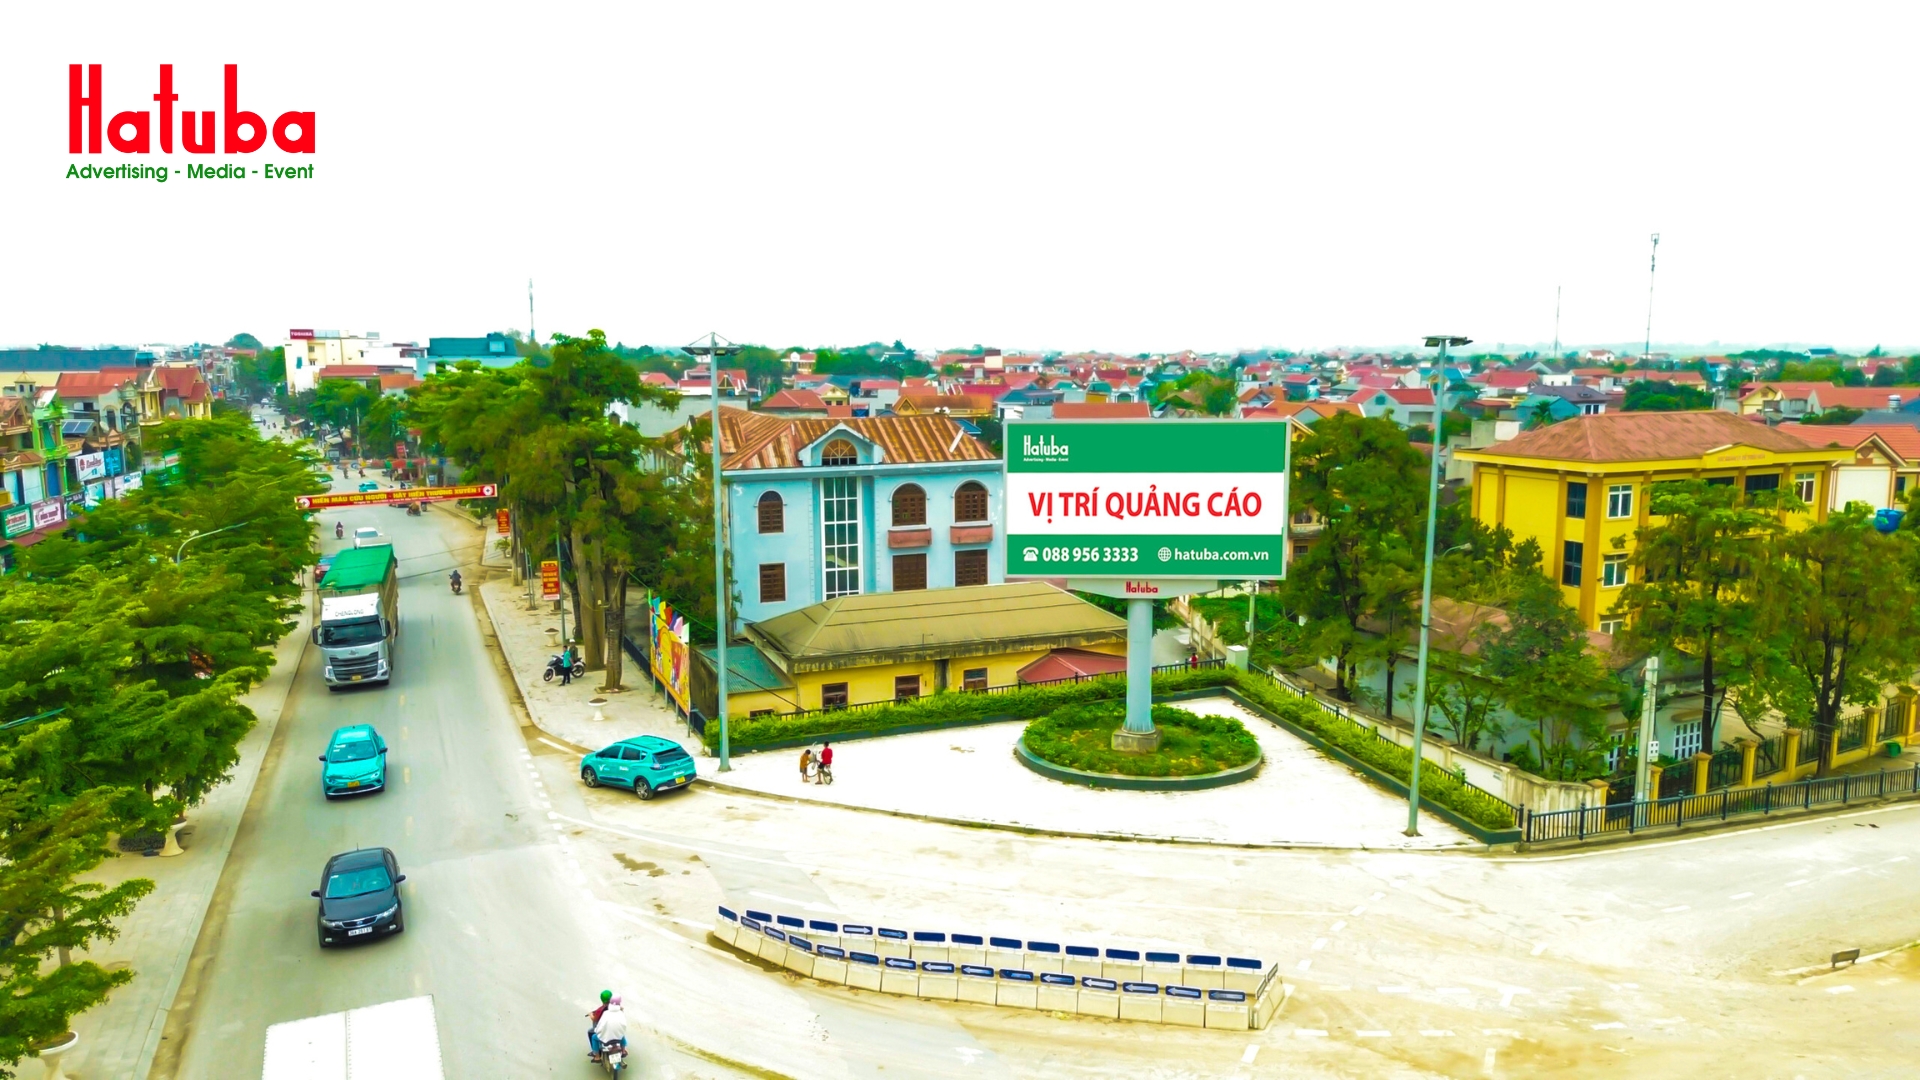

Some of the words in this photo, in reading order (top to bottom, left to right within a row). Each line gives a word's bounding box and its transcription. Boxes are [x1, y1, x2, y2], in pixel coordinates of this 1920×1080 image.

[1023, 434, 1069, 456] Hatuba
[1028, 492, 1053, 524] VỊ
[1059, 486, 1100, 517] TRÍ
[1105, 484, 1201, 520] QUẢNG
[1207, 486, 1263, 518] CÁO
[1042, 547, 1069, 562] 088
[1072, 547, 1100, 562] 956
[1103, 547, 1139, 562] 3333
[1174, 547, 1269, 561] hatuba.com.vn
[1125, 581, 1159, 594] Hatuba
